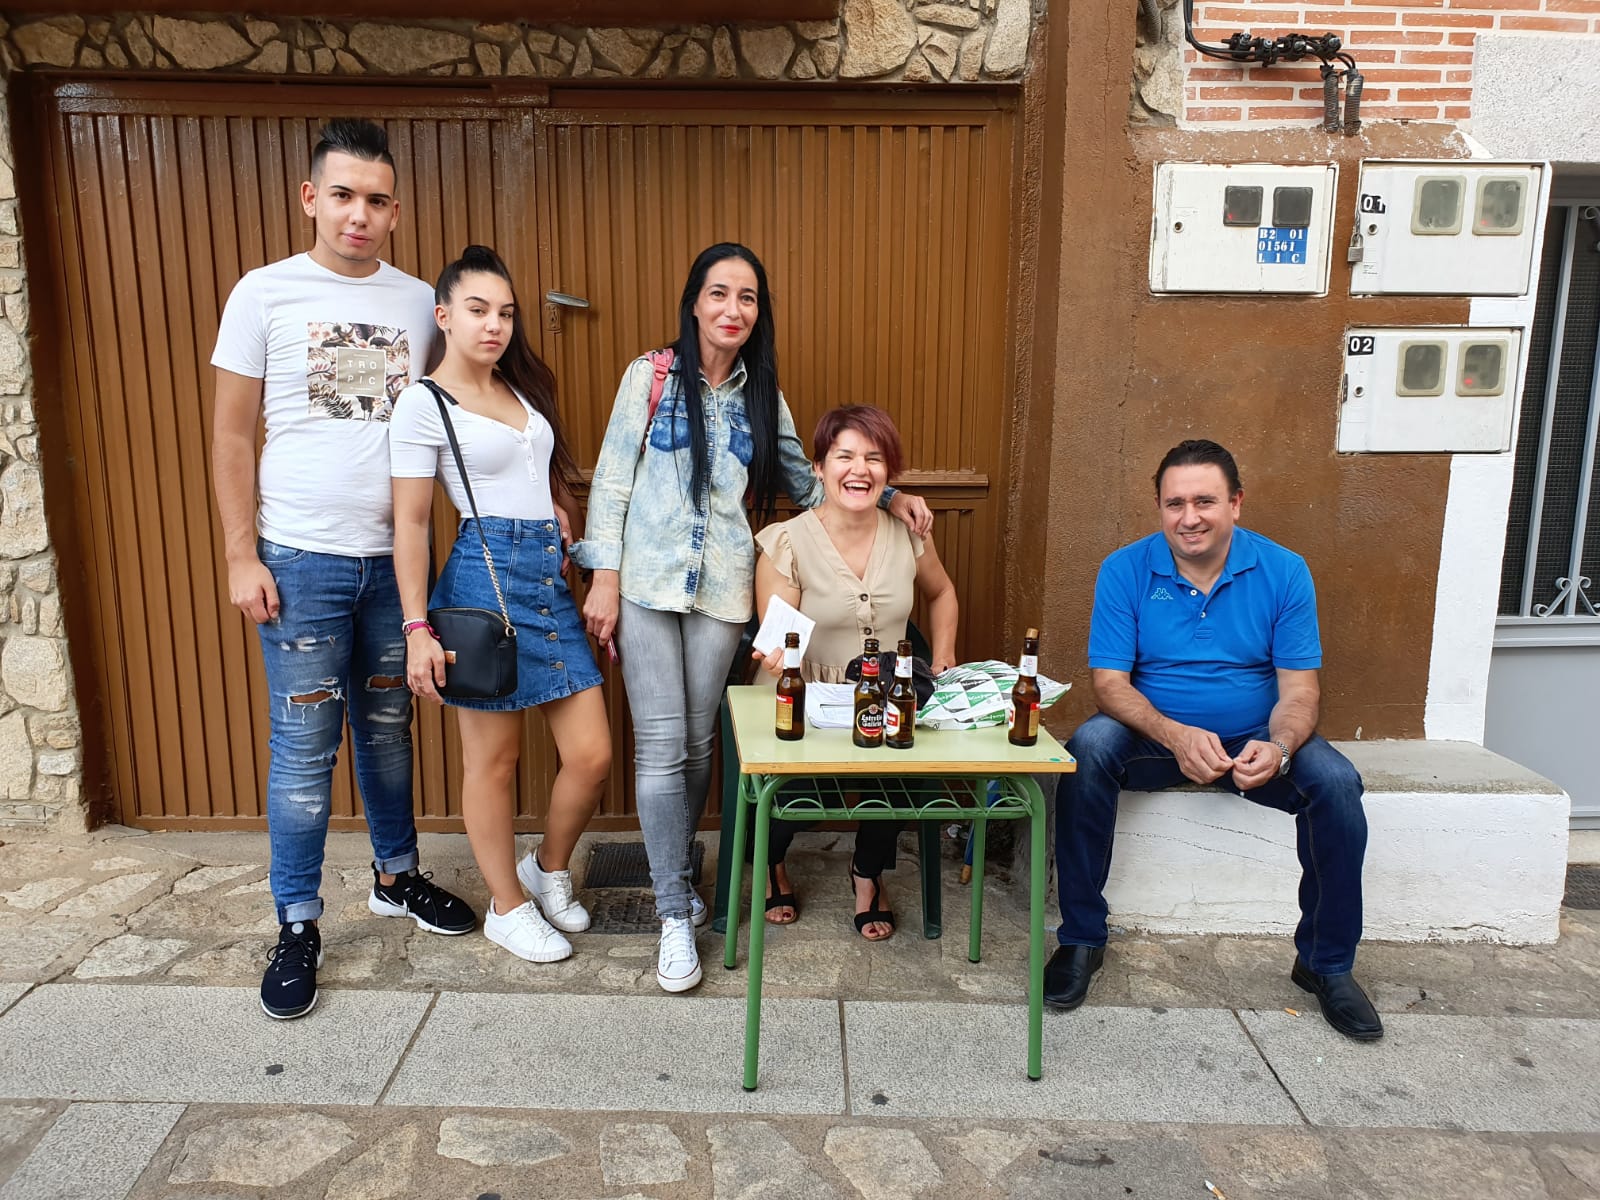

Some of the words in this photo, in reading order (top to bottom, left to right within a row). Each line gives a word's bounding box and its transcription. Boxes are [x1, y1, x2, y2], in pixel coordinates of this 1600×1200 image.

[1363, 196, 1383, 211] 01
[1259, 229, 1276, 240] B2
[1289, 229, 1303, 240] 01
[1291, 253, 1300, 264] C
[1350, 337, 1373, 352] 02
